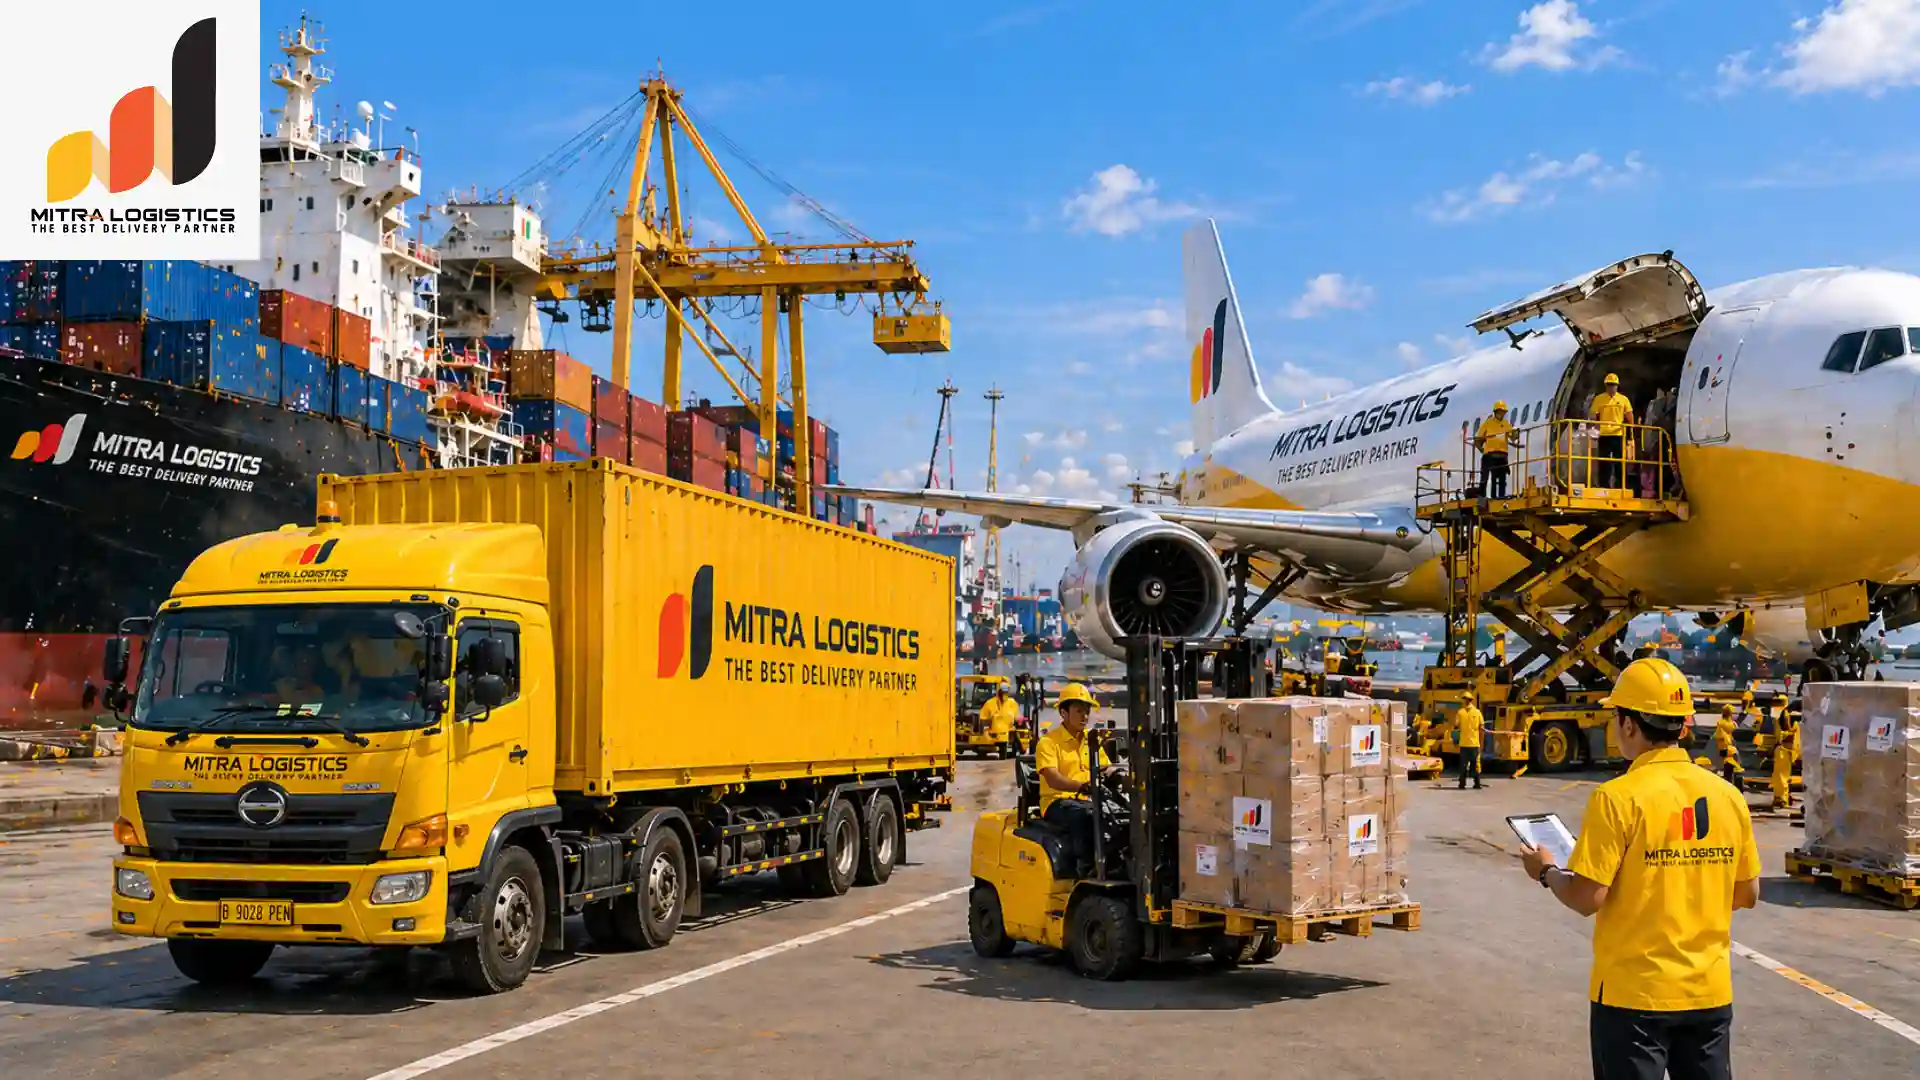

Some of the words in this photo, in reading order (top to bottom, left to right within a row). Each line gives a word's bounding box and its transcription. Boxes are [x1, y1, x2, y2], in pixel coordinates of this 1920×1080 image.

[1269, 419, 1333, 461] MITRA
[1333, 382, 1459, 444] LOGISTICS
[92, 431, 165, 462] MITRA
[170, 443, 263, 476] LOGISTICS
[1277, 466, 1293, 485] THE
[1295, 461, 1318, 481] BEST
[1319, 449, 1367, 476] DELIVERY
[1369, 436, 1419, 465] PARTNER
[88, 458, 116, 473] THE
[119, 462, 152, 478] BEST
[154, 467, 207, 486] DELIVERY
[208, 475, 255, 493] PARTNER
[260, 571, 291, 580] MITRA
[294, 569, 349, 578] LOGISTICS
[724, 600, 806, 649] MITRA
[814, 615, 920, 661] LOGISTICS
[724, 658, 753, 682] THE
[760, 660, 795, 684] BEST
[802, 663, 864, 688] DELIVERY
[869, 670, 917, 691] PARTNER
[184, 756, 242, 771] MITRA
[249, 756, 348, 772] LOGISTICS
[1644, 848, 1681, 860] MITRA
[1683, 847, 1734, 859] LOGISTICS
[222, 903, 230, 920] B
[236, 903, 263, 921] 9028
[269, 904, 290, 921] PEN
